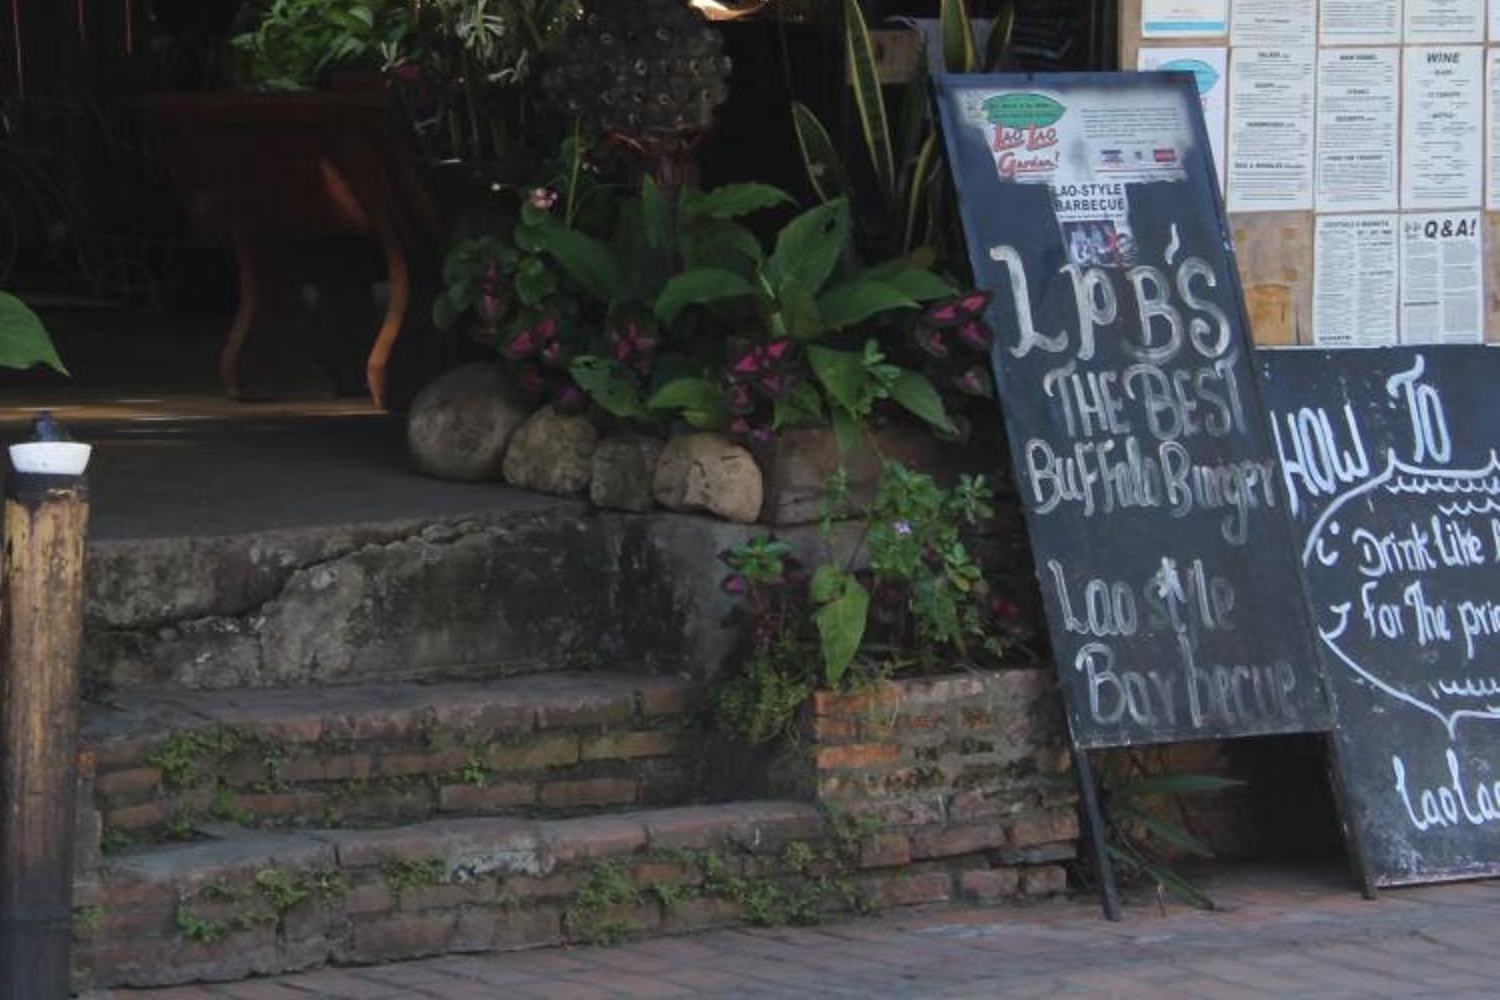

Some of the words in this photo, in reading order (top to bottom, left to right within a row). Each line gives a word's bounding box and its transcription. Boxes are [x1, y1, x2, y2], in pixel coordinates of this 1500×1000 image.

[1427, 52, 1461, 64] WINE
[1044, 360, 1131, 438] THE
[1124, 350, 1246, 441] BEST
[1352, 522, 1437, 577] Drink
[1047, 558, 1138, 637] Lao
